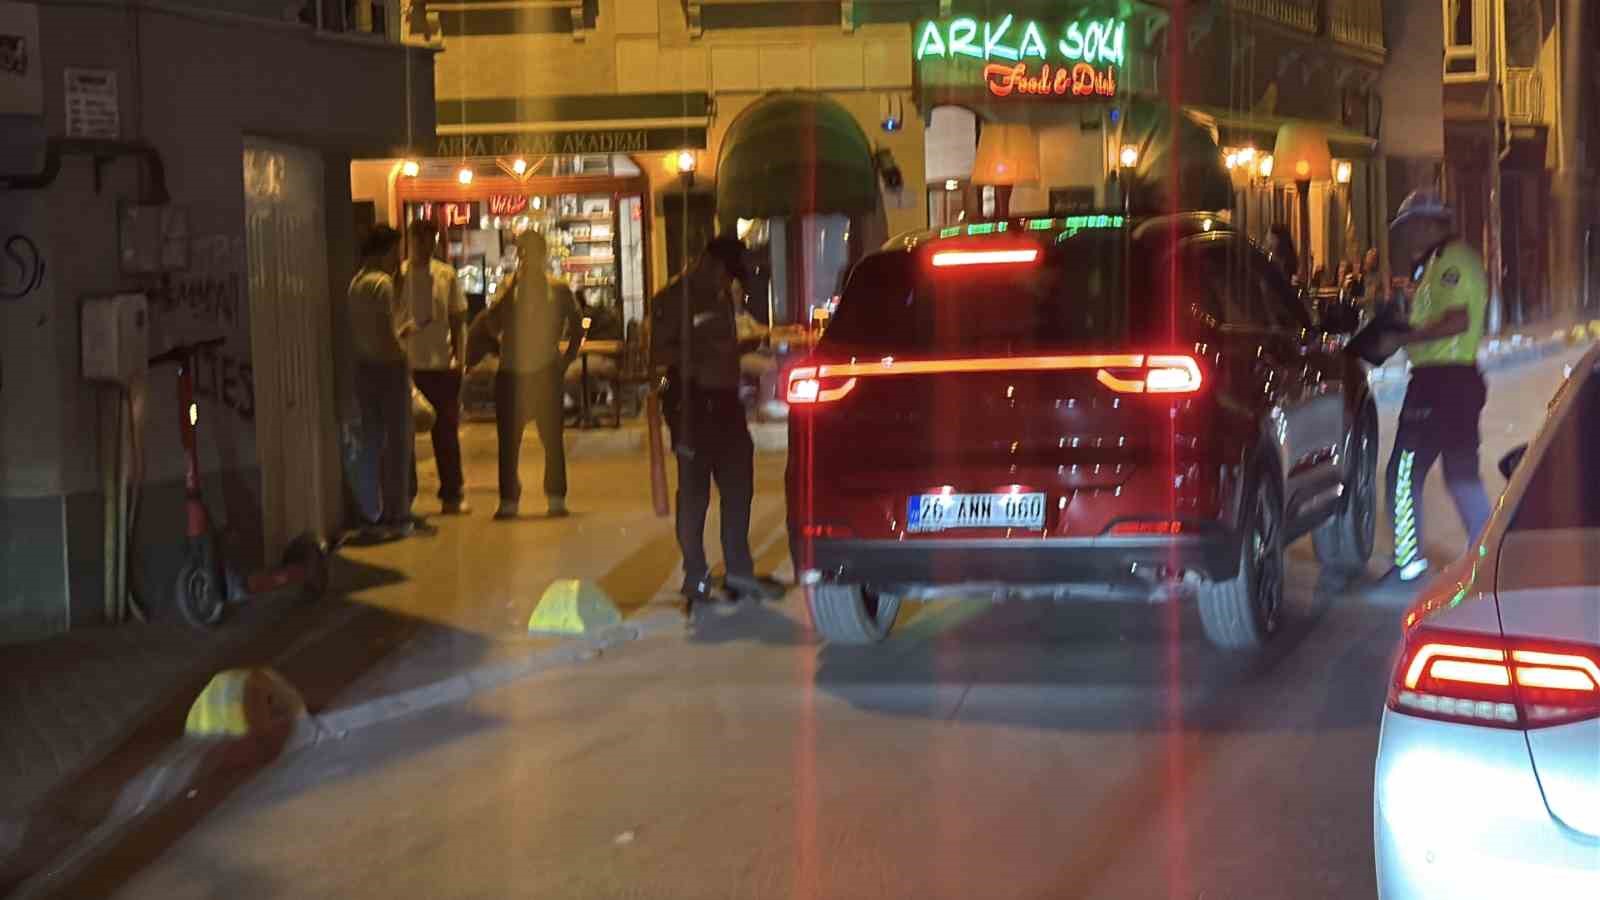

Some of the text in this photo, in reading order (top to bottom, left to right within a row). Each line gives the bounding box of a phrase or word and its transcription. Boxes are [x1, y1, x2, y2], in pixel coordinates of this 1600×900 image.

[917, 14, 1047, 61] ARKA
[984, 63, 1051, 97] Food
[1053, 69, 1071, 95] &
[922, 497, 944, 522] 26
[957, 496, 992, 520] ANN
